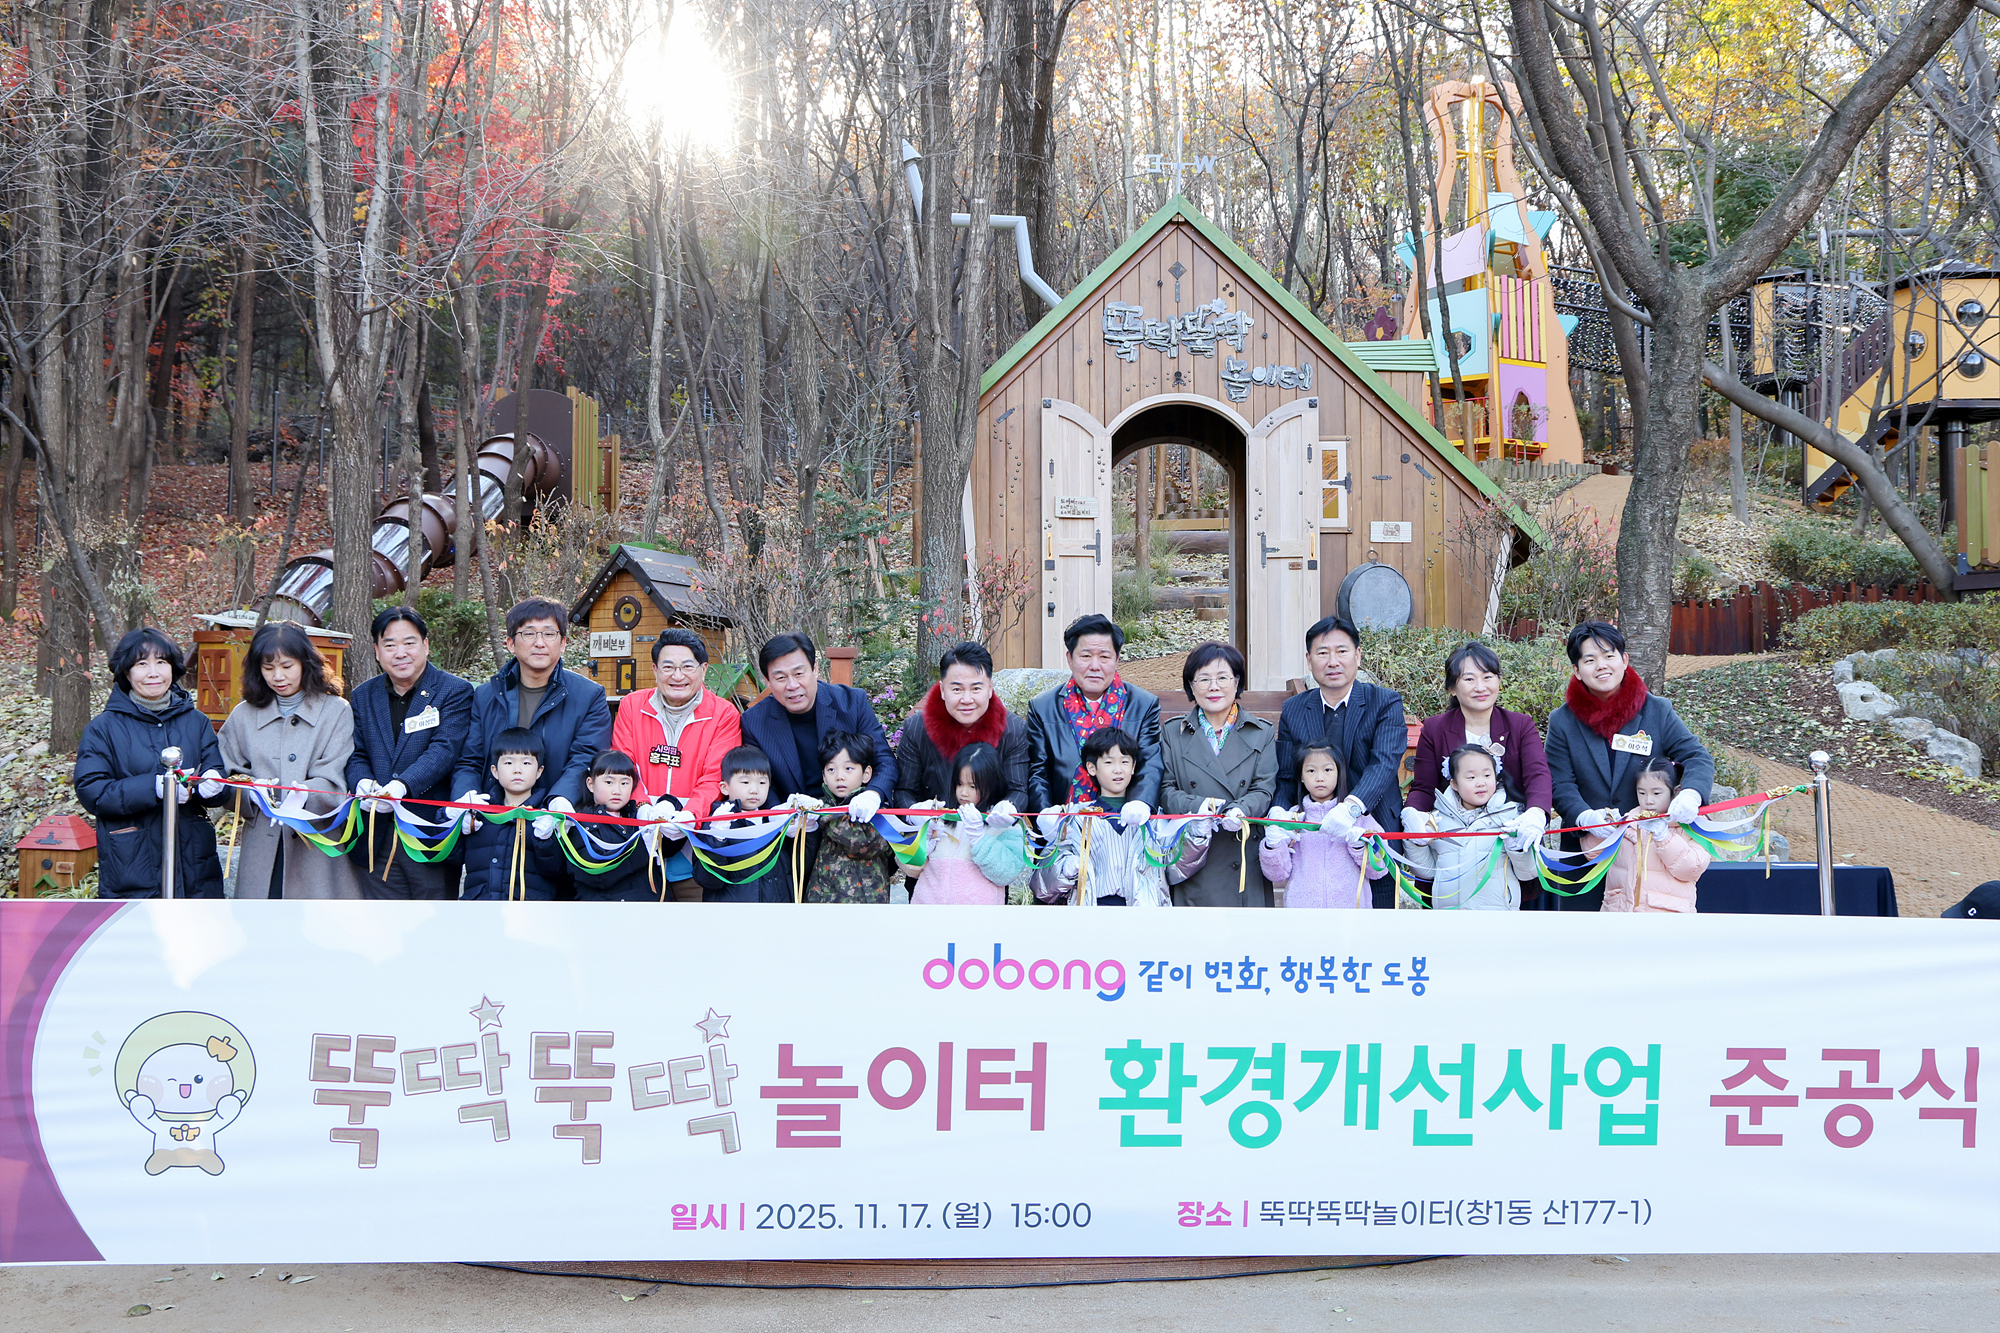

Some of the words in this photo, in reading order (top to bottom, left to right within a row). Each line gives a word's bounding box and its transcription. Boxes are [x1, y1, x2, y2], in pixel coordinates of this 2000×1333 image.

[593, 634, 626, 651] 깨비본부
[649, 752, 681, 767] 홍국표
[655, 745, 677, 756] 시의원
[923, 943, 1125, 1001] dobong
[1138, 960, 1191, 993] 같이
[1204, 956, 1270, 995] 변화,
[1280, 956, 1373, 994] 행복한
[1382, 956, 1430, 996] 도봉
[1099, 1039, 1661, 1149] 환경개선사업
[1710, 1046, 1980, 1148] 준공식
[671, 1203, 727, 1231] 일시
[756, 1203, 843, 1230] 2025.
[855, 1203, 886, 1230] 11.
[898, 1203, 931, 1230] 17.
[942, 1201, 992, 1230] (월)
[1011, 1202, 1091, 1228] 15:00
[1178, 1200, 1231, 1228] 장소
[1260, 1199, 1532, 1227] 뚝딱뚝딱놀이터(창1동
[1543, 1199, 1652, 1226] 산177-1)
